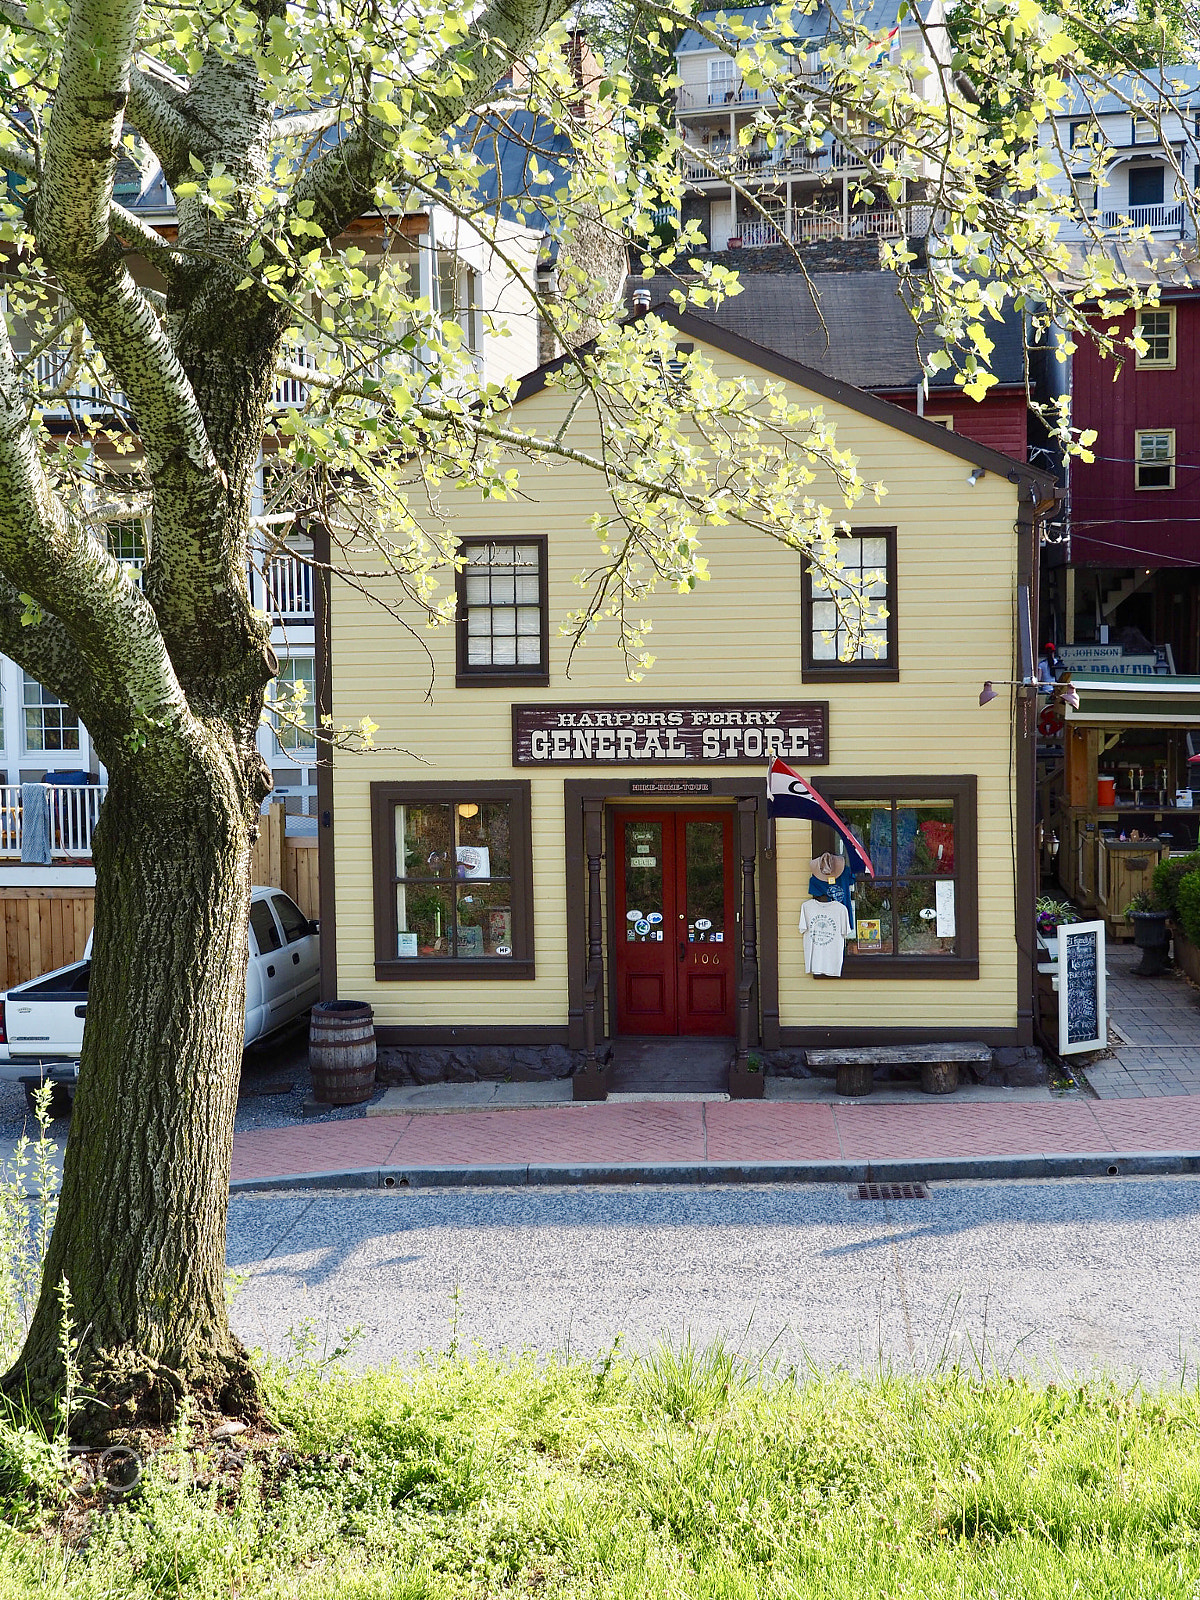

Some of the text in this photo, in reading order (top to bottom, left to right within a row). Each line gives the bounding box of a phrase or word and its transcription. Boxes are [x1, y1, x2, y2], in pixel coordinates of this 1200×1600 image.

[1061, 648, 1119, 658] J. JOHNSON
[557, 711, 781, 727] HARPERS FERRY
[531, 727, 810, 760] GENERAL STORE
[694, 953, 720, 965] 106
